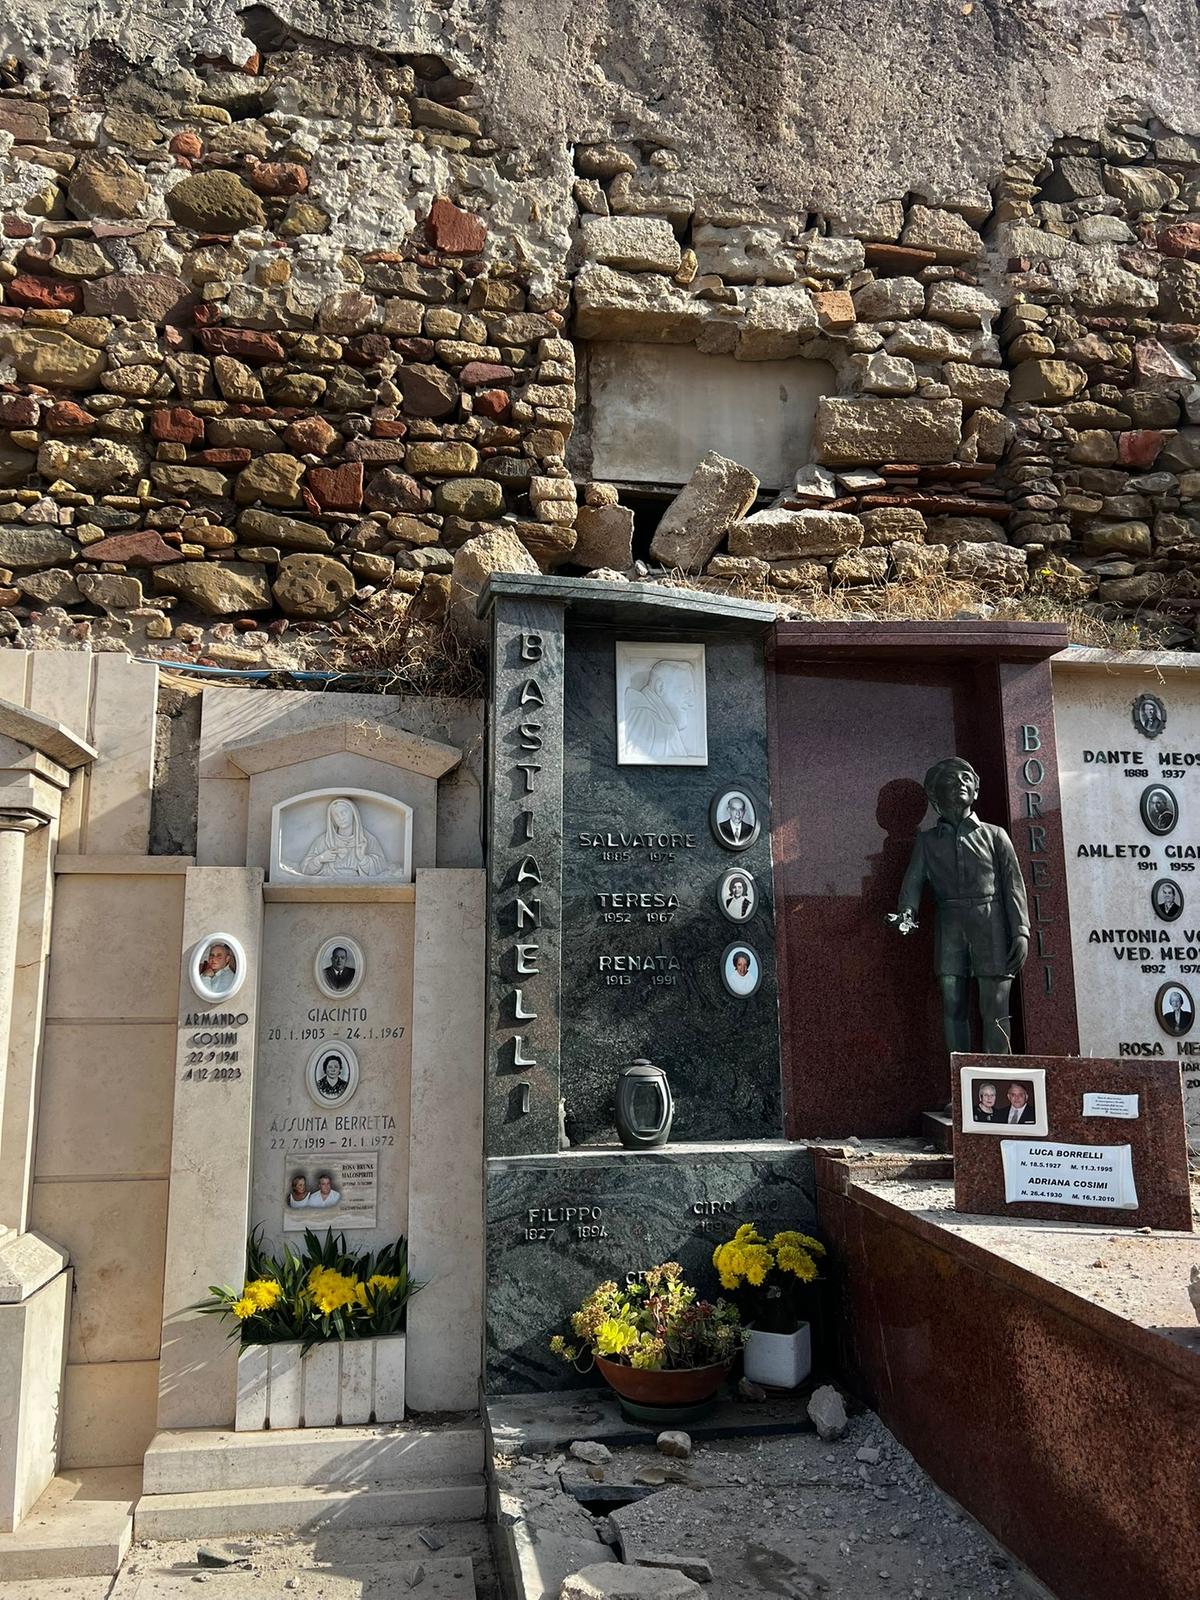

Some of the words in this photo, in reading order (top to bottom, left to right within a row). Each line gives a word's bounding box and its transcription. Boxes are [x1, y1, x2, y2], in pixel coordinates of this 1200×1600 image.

[1083, 750, 1144, 765] DANTE
[1161, 769, 1186, 779] 1937
[579, 832, 697, 848] SALVATORE
[602, 851, 631, 861] 1885
[650, 851, 676, 862] 1975
[1077, 844, 1151, 858] AMLETO
[1164, 844, 1200, 859] GIA
[1021, 724, 1055, 995] BORRELLI
[513, 633, 546, 1113] BASTIANELLI
[1137, 861, 1158, 871] 1911
[1170, 862, 1195, 872] 1955
[597, 893, 680, 908] TERESA
[604, 912, 632, 923] 1952
[646, 912, 675, 923] 1967
[1088, 929, 1171, 943] ANTONIA
[1113, 946, 1154, 960] VED.
[1160, 946, 1200, 960] MEO
[599, 955, 681, 971] RENATA
[1141, 964, 1166, 974] 1892
[605, 975, 632, 985] 1913
[651, 975, 677, 985] 1991
[185, 1013, 249, 1026] ARMANDO
[307, 1008, 368, 1022] GIACINTO
[193, 1032, 238, 1045] COSIMI
[1119, 1042, 1165, 1056] ROSA
[1177, 1041, 1200, 1056] ME
[190, 1051, 204, 1063] 22
[209, 1051, 216, 1062] 9
[198, 1068, 209, 1080] 12
[214, 1067, 242, 1080] 2023
[270, 1117, 328, 1132] ASSUNTA
[335, 1115, 396, 1131] BERRETTA
[1029, 1148, 1054, 1157] LUCA
[1056, 1150, 1104, 1160] BORRELLI
[1030, 1161, 1061, 1169] 18.5.1927
[1028, 1177, 1070, 1187] ADRIANA
[1073, 1180, 1108, 1189] COSIMI
[1082, 1194, 1115, 1202] 16.1.2010
[528, 1206, 602, 1222] FILIPPO
[524, 1228, 556, 1240] 1827
[577, 1225, 609, 1239] 1894
